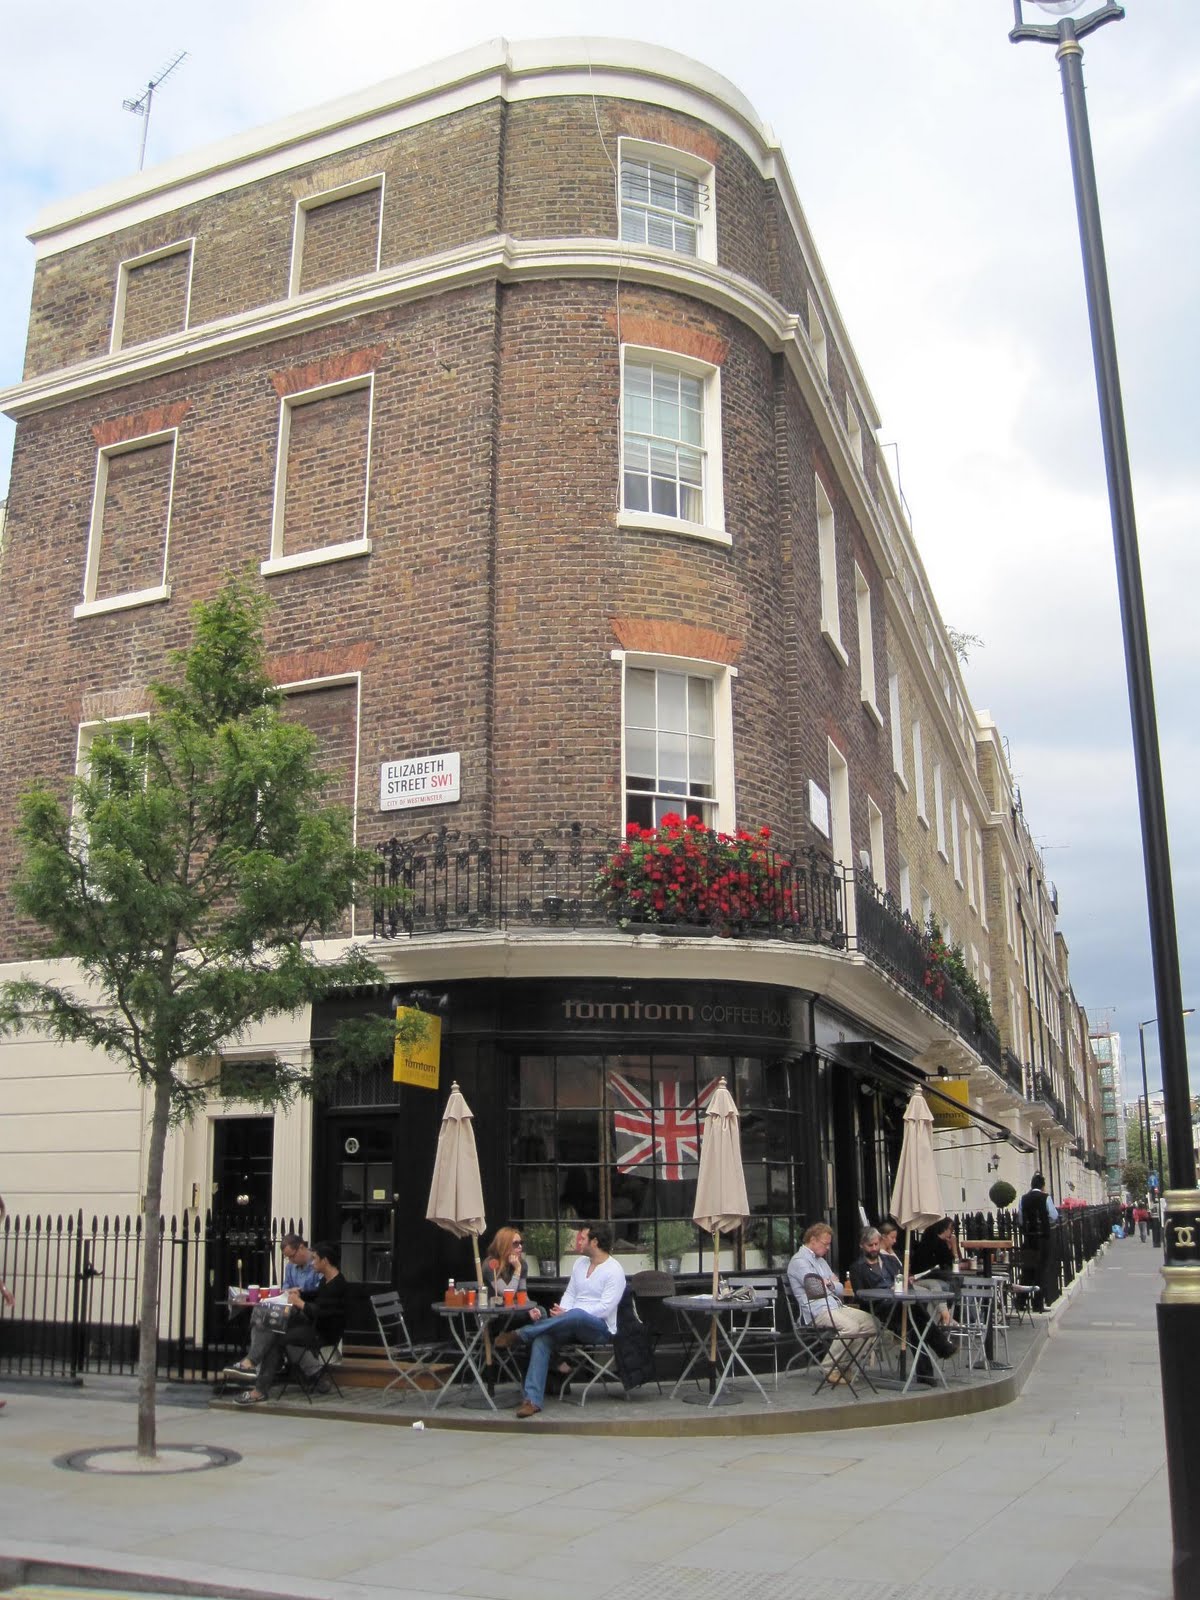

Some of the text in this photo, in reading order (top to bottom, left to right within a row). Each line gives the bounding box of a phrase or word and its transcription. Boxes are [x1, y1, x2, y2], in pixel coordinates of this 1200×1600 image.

[387, 759, 444, 779] ELIZABETH
[387, 773, 453, 794] STREET SW1
[407, 794, 443, 804] WESTMINSTER
[561, 999, 694, 1021] tomtom
[700, 1004, 758, 1024] COFFEE
[405, 1058, 436, 1074] tomtom
